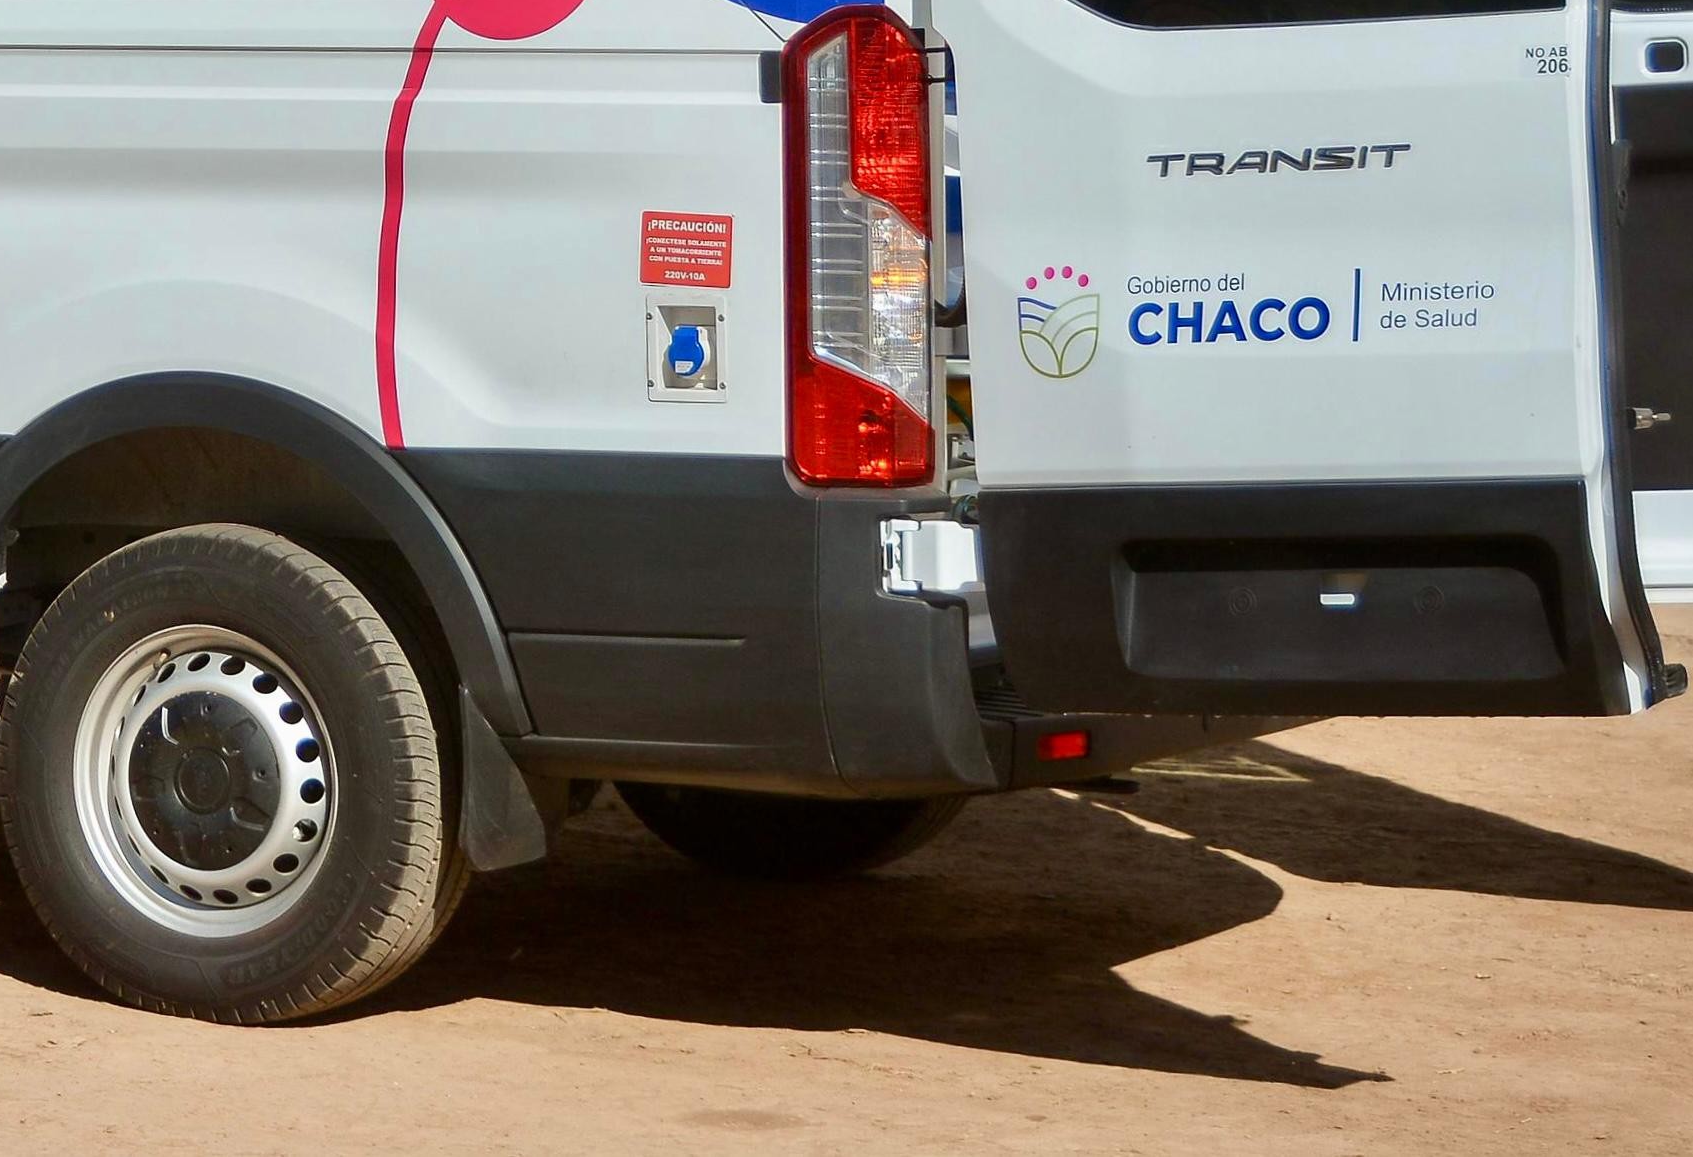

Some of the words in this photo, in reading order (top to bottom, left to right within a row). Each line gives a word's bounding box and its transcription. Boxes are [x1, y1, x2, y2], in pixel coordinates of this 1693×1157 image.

[1525, 47, 1545, 58] NO
[1147, 144, 1411, 177] TRANSIT
[648, 220, 726, 233] ¡PRECAUCIÓN!
[664, 270, 706, 281] 220V-10A
[1127, 275, 1211, 295] Gobierno
[1217, 273, 1245, 292] del
[1381, 280, 1495, 302] Ministerio
[1128, 296, 1330, 345] CHACO
[1380, 310, 1407, 329] de
[1415, 307, 1477, 328] Salud
